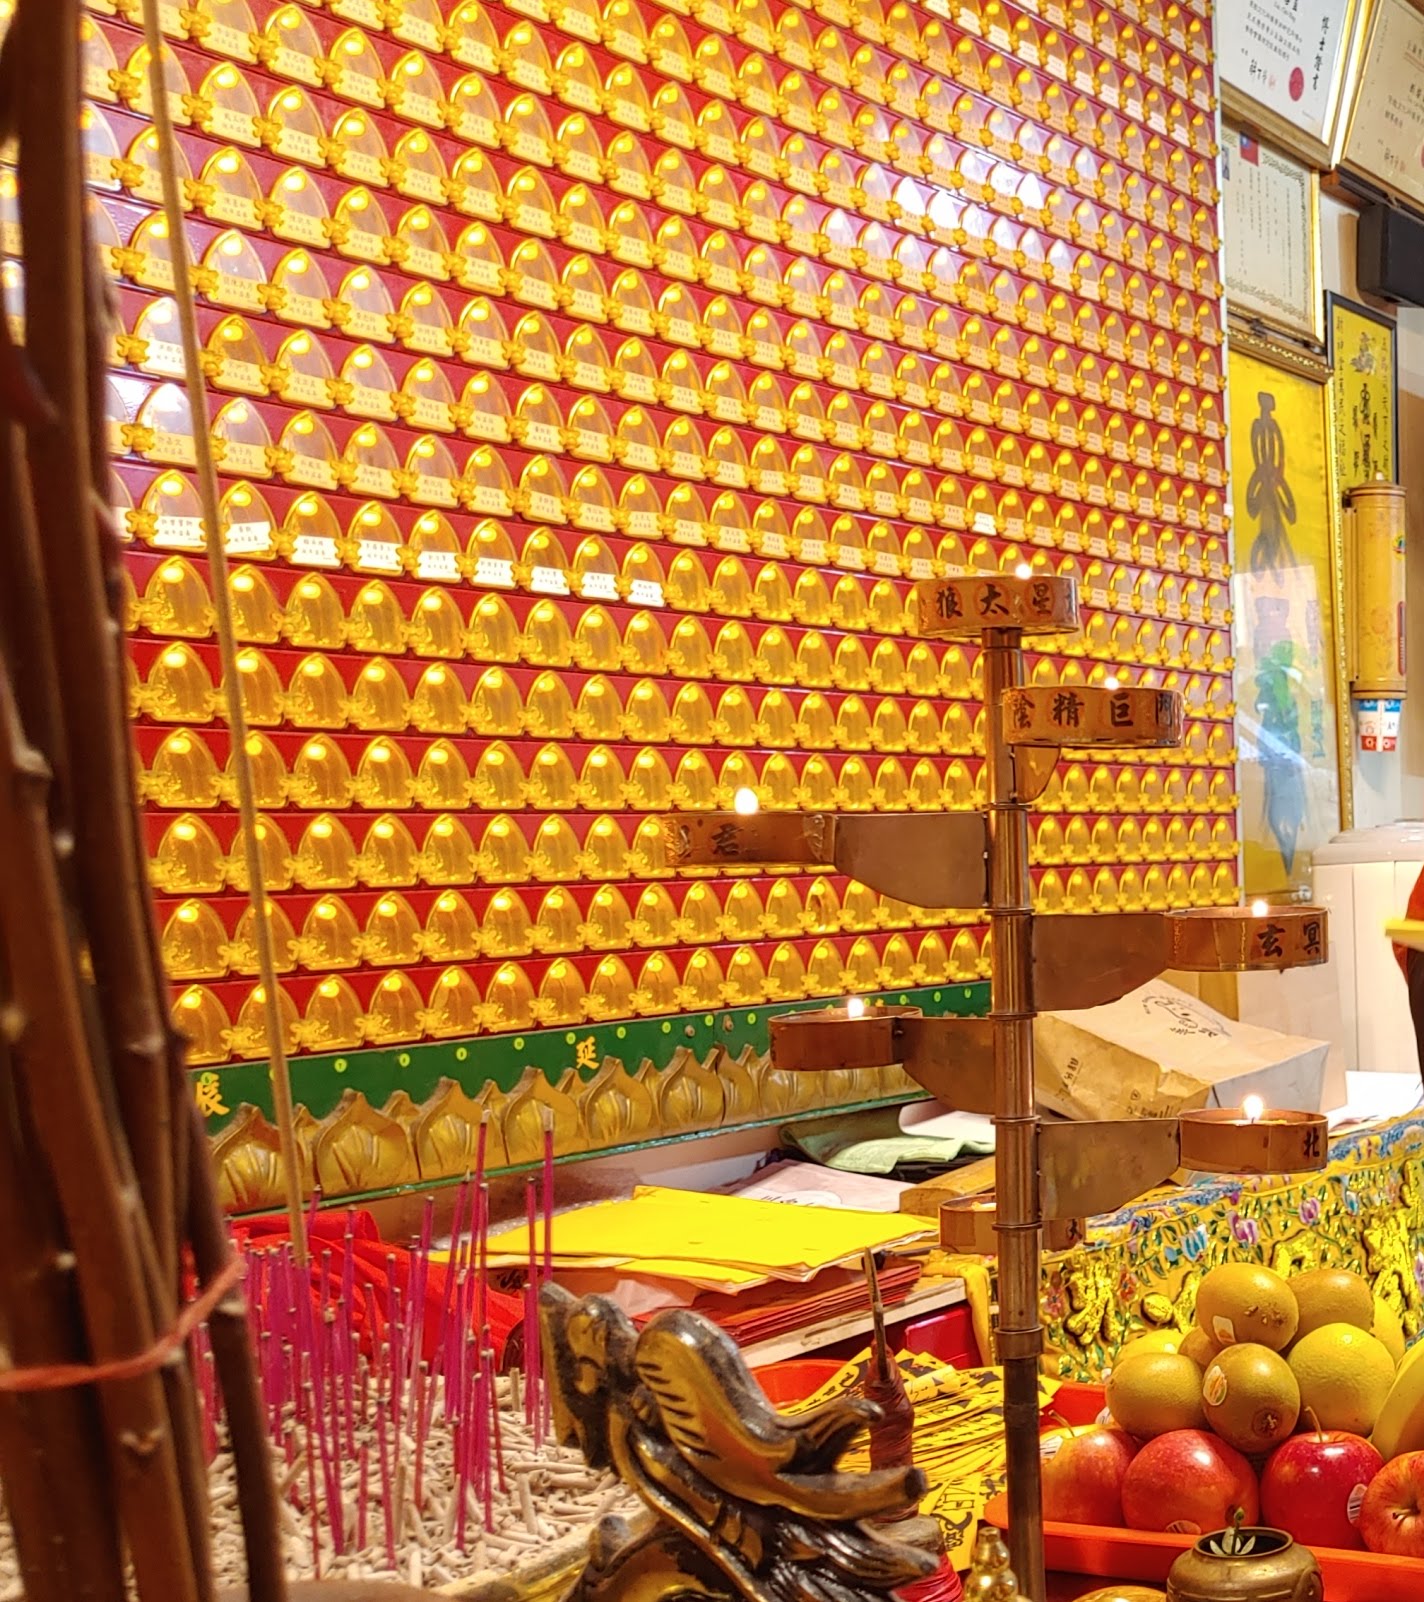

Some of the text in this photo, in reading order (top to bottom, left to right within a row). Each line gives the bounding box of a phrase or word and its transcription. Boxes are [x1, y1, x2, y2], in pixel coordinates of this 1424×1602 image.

[936, 583, 1073, 618] 狼太星
[575, 1035, 600, 1069] 延
